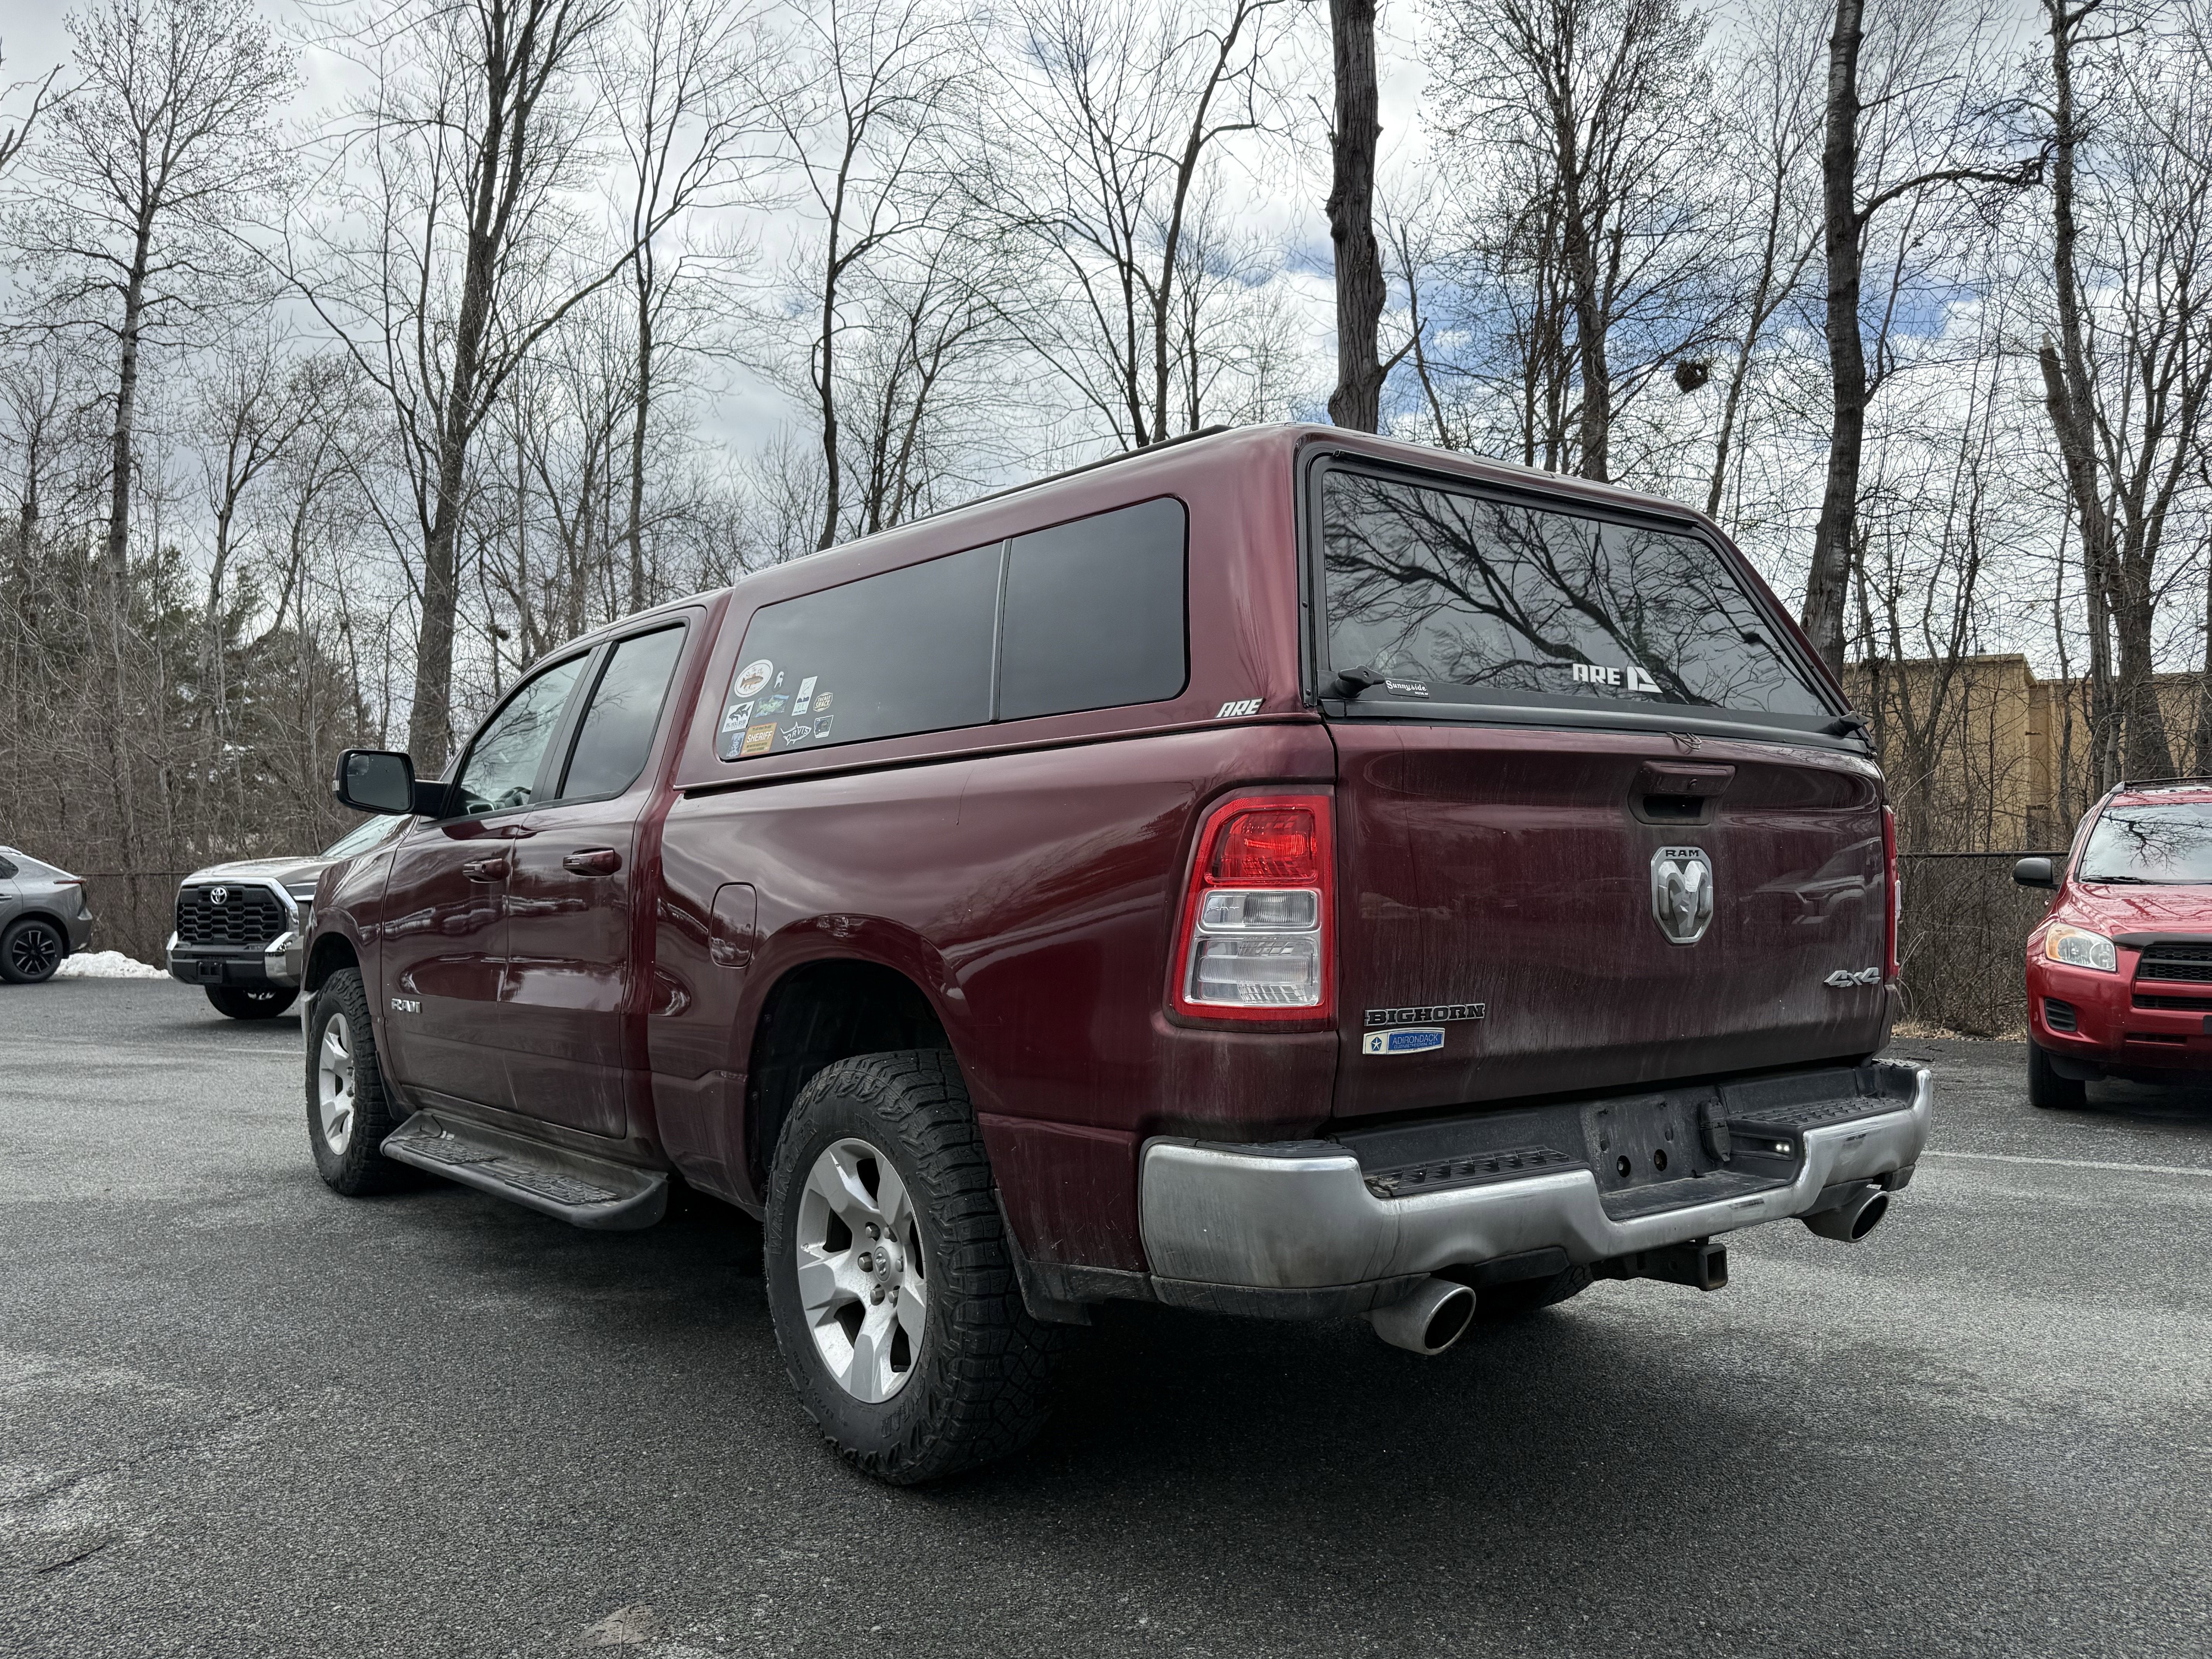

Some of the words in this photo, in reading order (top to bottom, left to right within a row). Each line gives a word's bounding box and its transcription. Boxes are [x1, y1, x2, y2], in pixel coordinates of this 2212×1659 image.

[1573, 663, 1620, 685] ARE
[1385, 680, 1427, 691] Sunnyside
[1216, 697, 1263, 718] ARE
[747, 731, 772, 743] SHERIFF
[785, 727, 809, 741] ORVIS
[391, 998, 421, 1014] RAM
[1364, 1003, 1485, 1026] BIGHORN
[1392, 1033, 1438, 1045] ADIRONDACK
